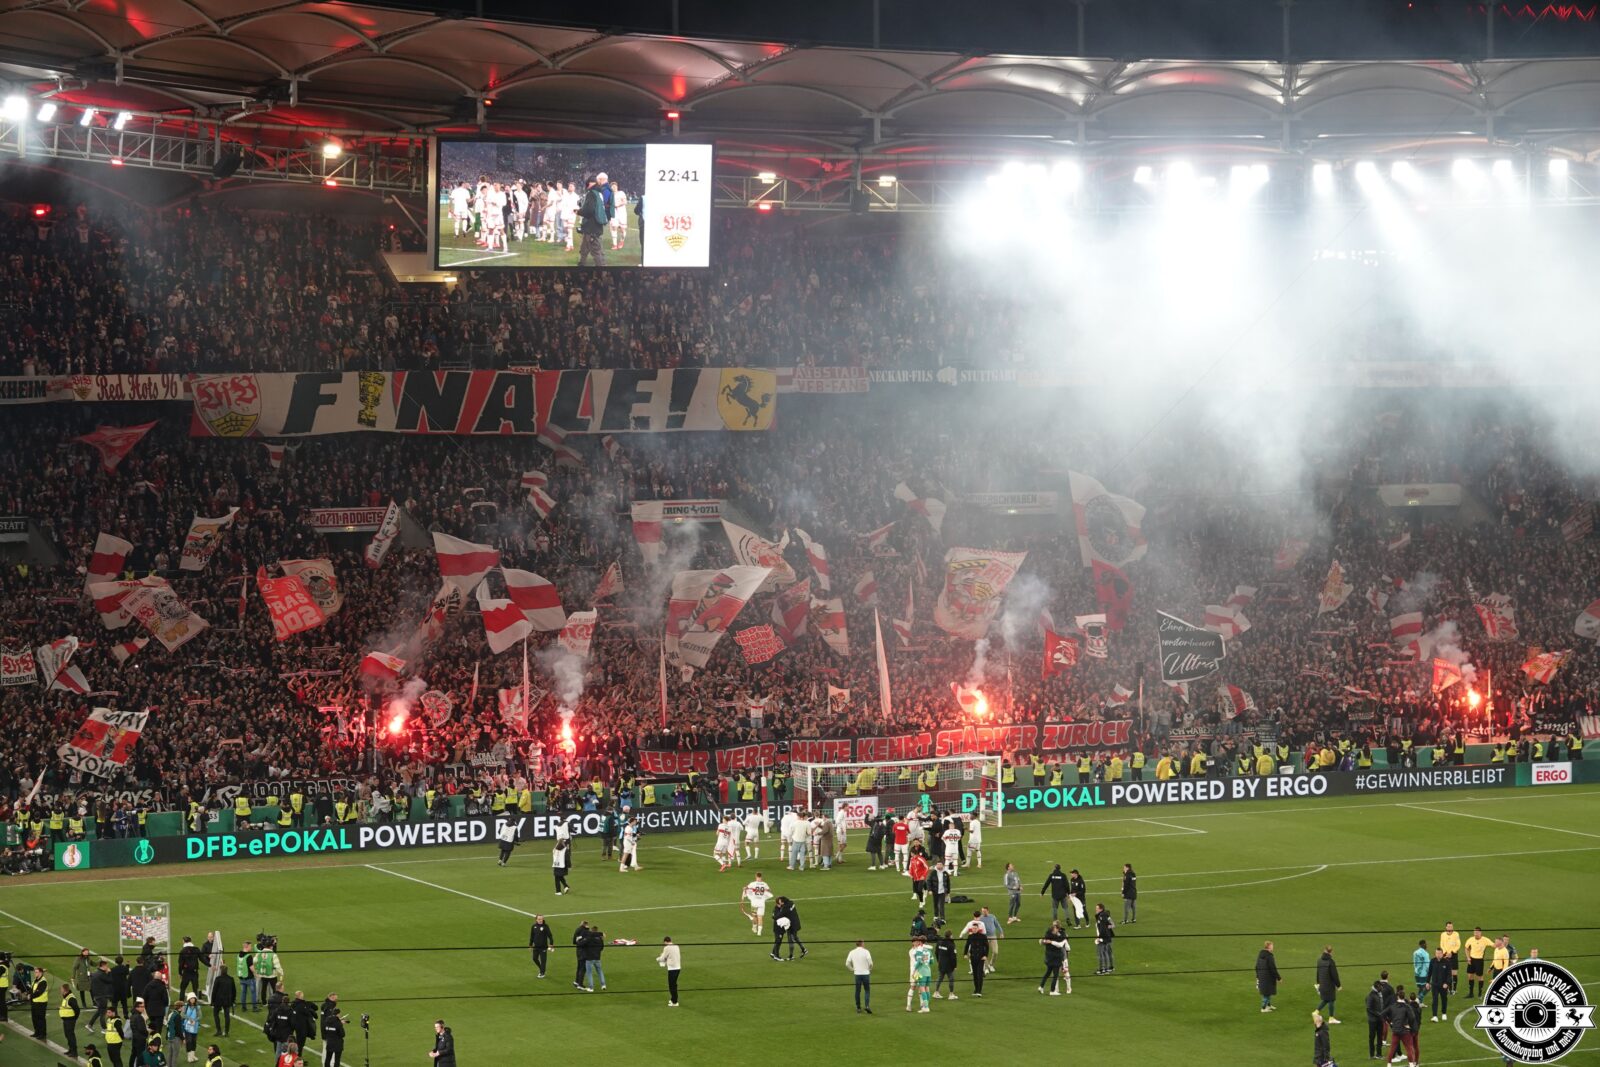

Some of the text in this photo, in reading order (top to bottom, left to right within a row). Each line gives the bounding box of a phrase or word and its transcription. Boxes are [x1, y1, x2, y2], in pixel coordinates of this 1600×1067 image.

[658, 169, 699, 182] 22:41
[96, 374, 178, 400] Red Hots 96
[700, 506, 719, 514] 0711
[639, 750, 710, 774] JEDER
[857, 732, 932, 762] KEHRT
[1355, 768, 1506, 790] #GEWINNERBLEIBT
[1536, 769, 1568, 782] ERGO
[1112, 779, 1225, 804] POWERED
[1236, 778, 1260, 797] BY
[1266, 774, 1328, 796] ERGO
[636, 804, 803, 829] #GEWINNERBEIBT
[187, 829, 352, 859] DFB-ePOKAL
[360, 820, 487, 848] POWERED
